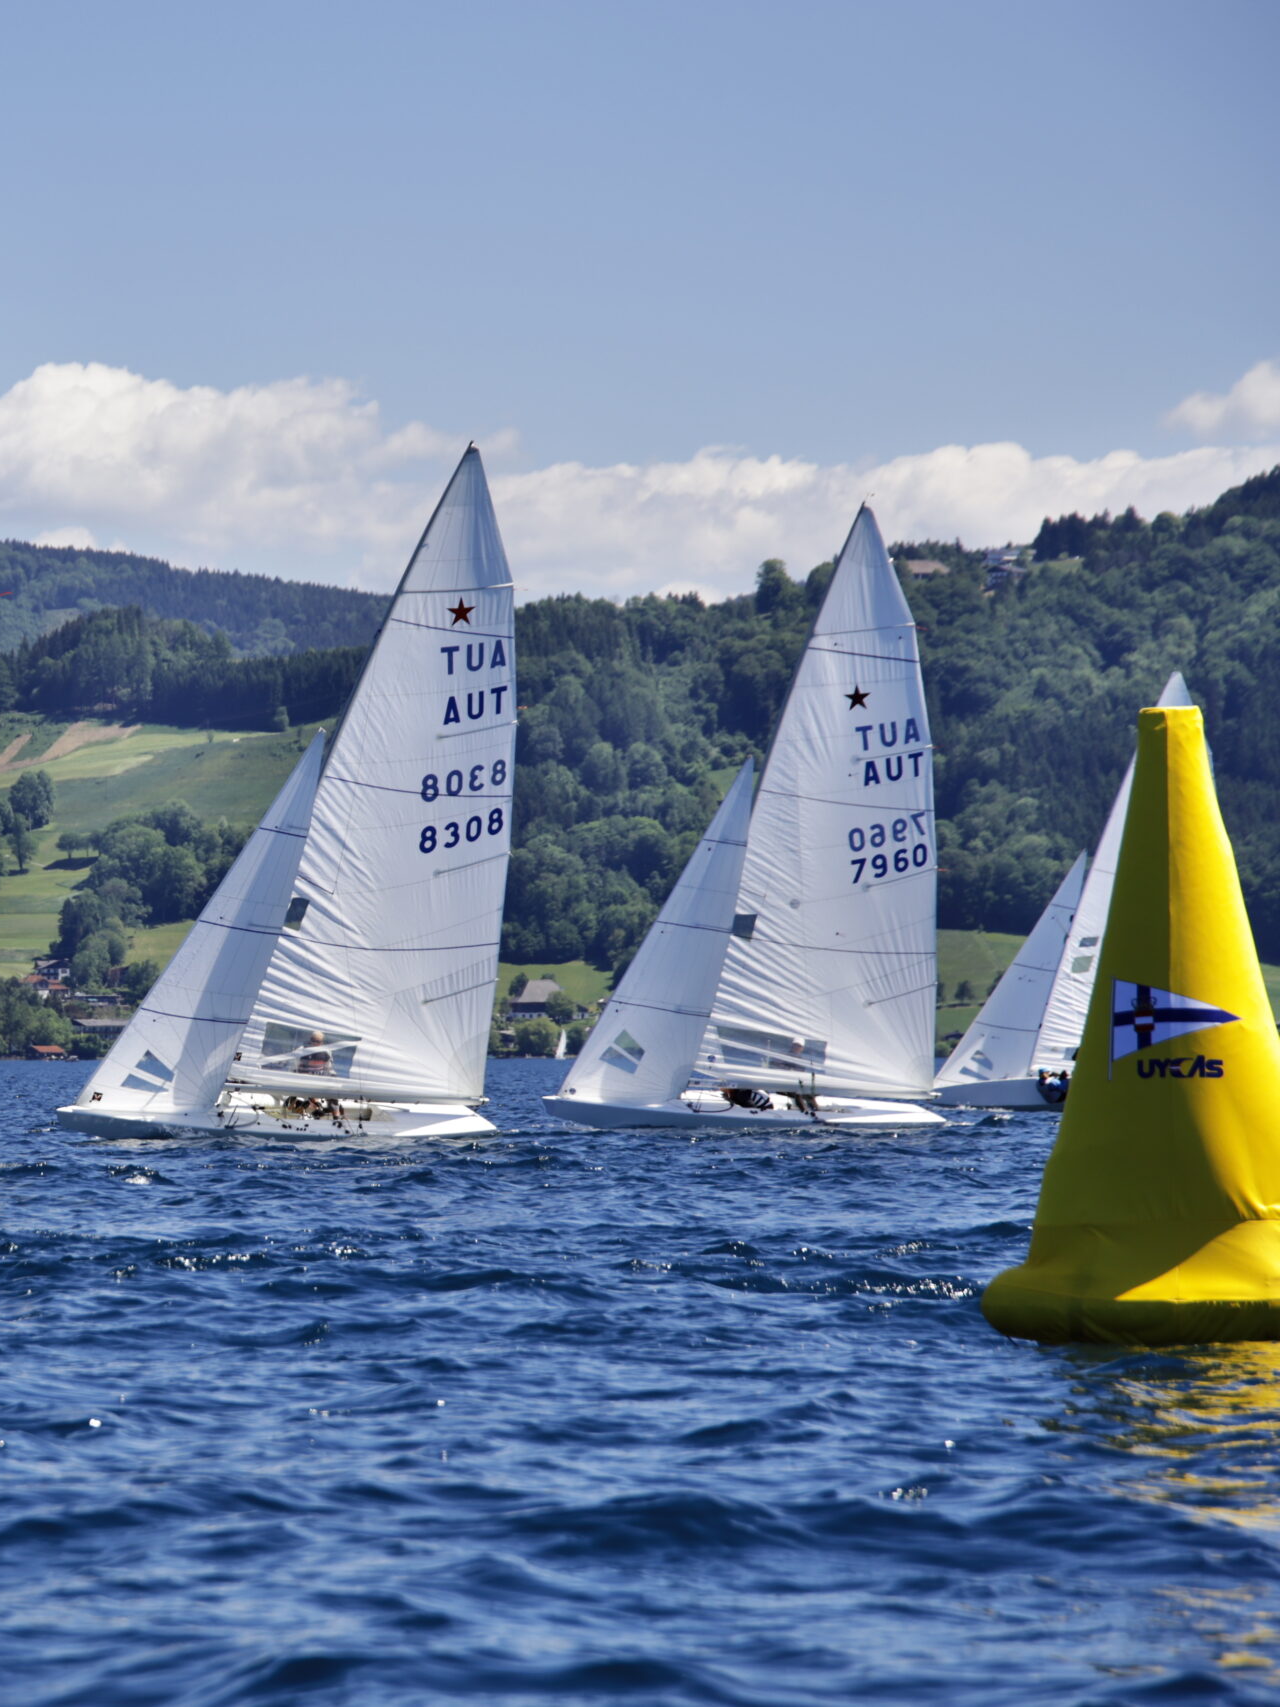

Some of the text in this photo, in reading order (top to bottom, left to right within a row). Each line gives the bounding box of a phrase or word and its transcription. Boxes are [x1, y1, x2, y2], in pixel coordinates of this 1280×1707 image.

[443, 685, 508, 725] AUT
[864, 752, 923, 786] AUT
[419, 808, 503, 854] 8308
[850, 843, 928, 884] 7960
